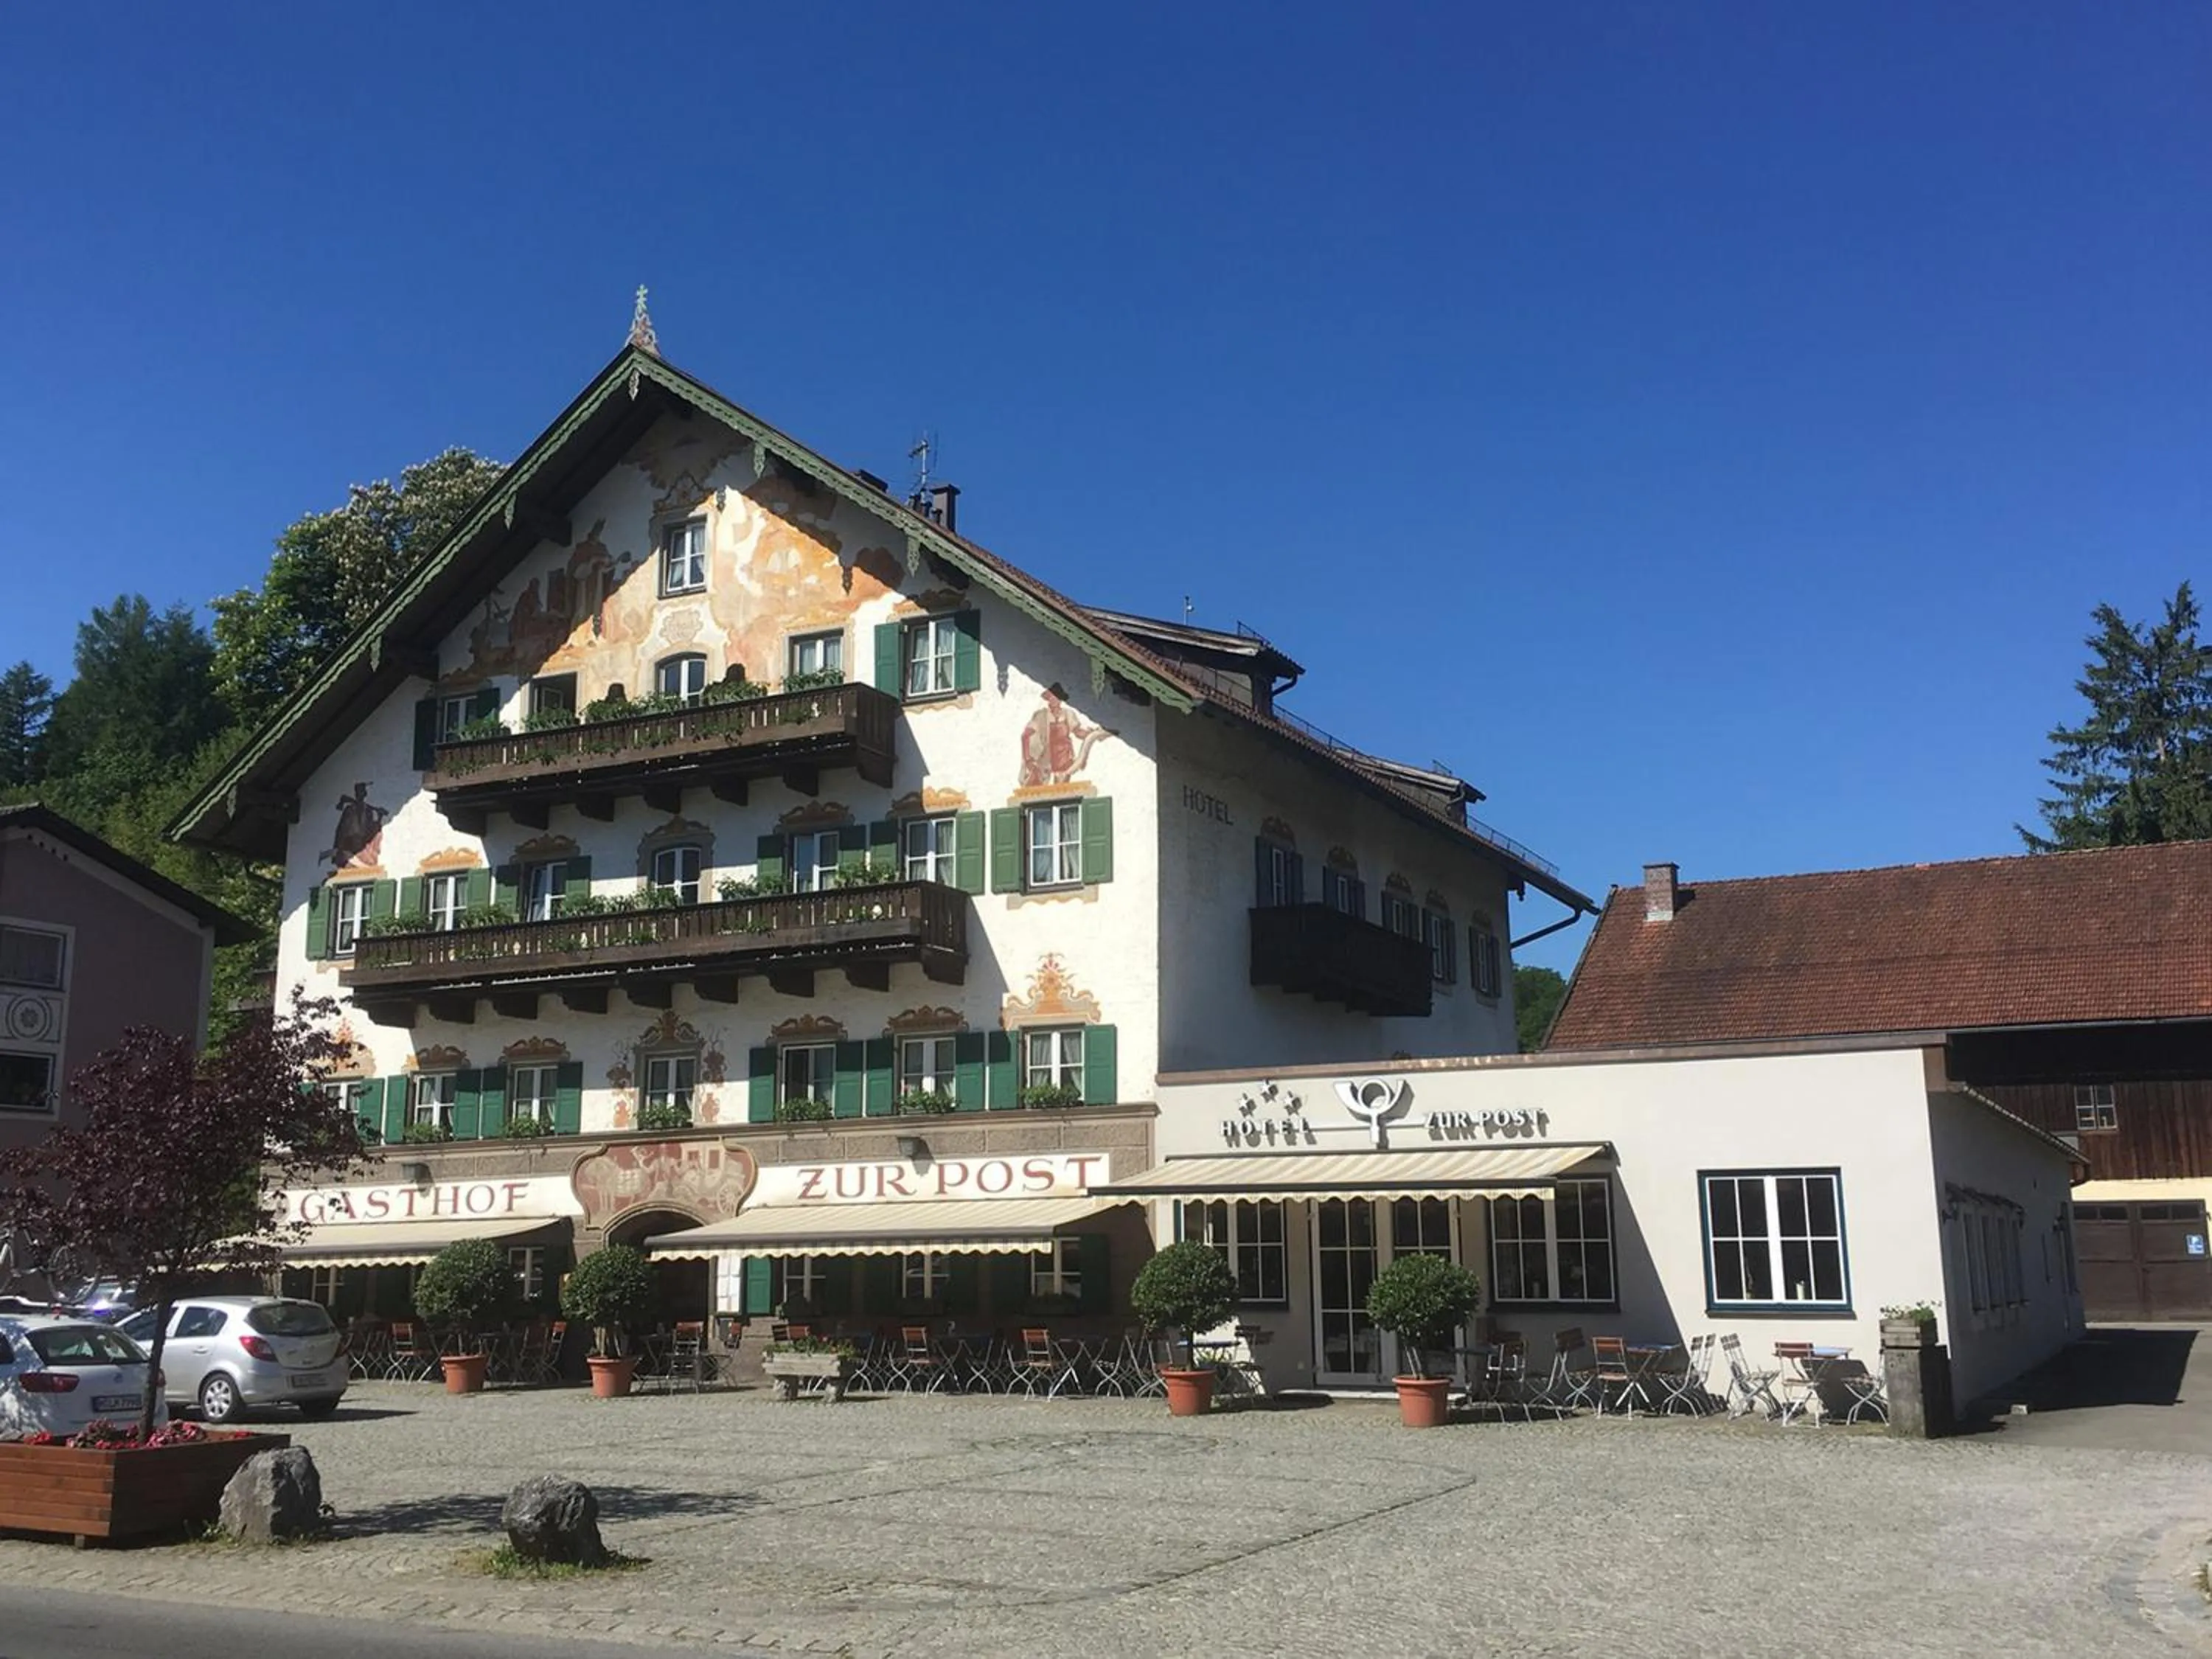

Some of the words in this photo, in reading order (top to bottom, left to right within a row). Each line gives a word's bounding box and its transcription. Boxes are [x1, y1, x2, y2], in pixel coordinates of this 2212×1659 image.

[1183, 785, 1234, 826] HOTEL
[1220, 1117, 1312, 1136] HOTEL
[1425, 1110, 1470, 1129] ZUR
[1478, 1107, 1545, 1128] POST
[797, 1165, 917, 1200] ZUR
[934, 1156, 1102, 1195] POST
[299, 1182, 529, 1222] GASTHOF
